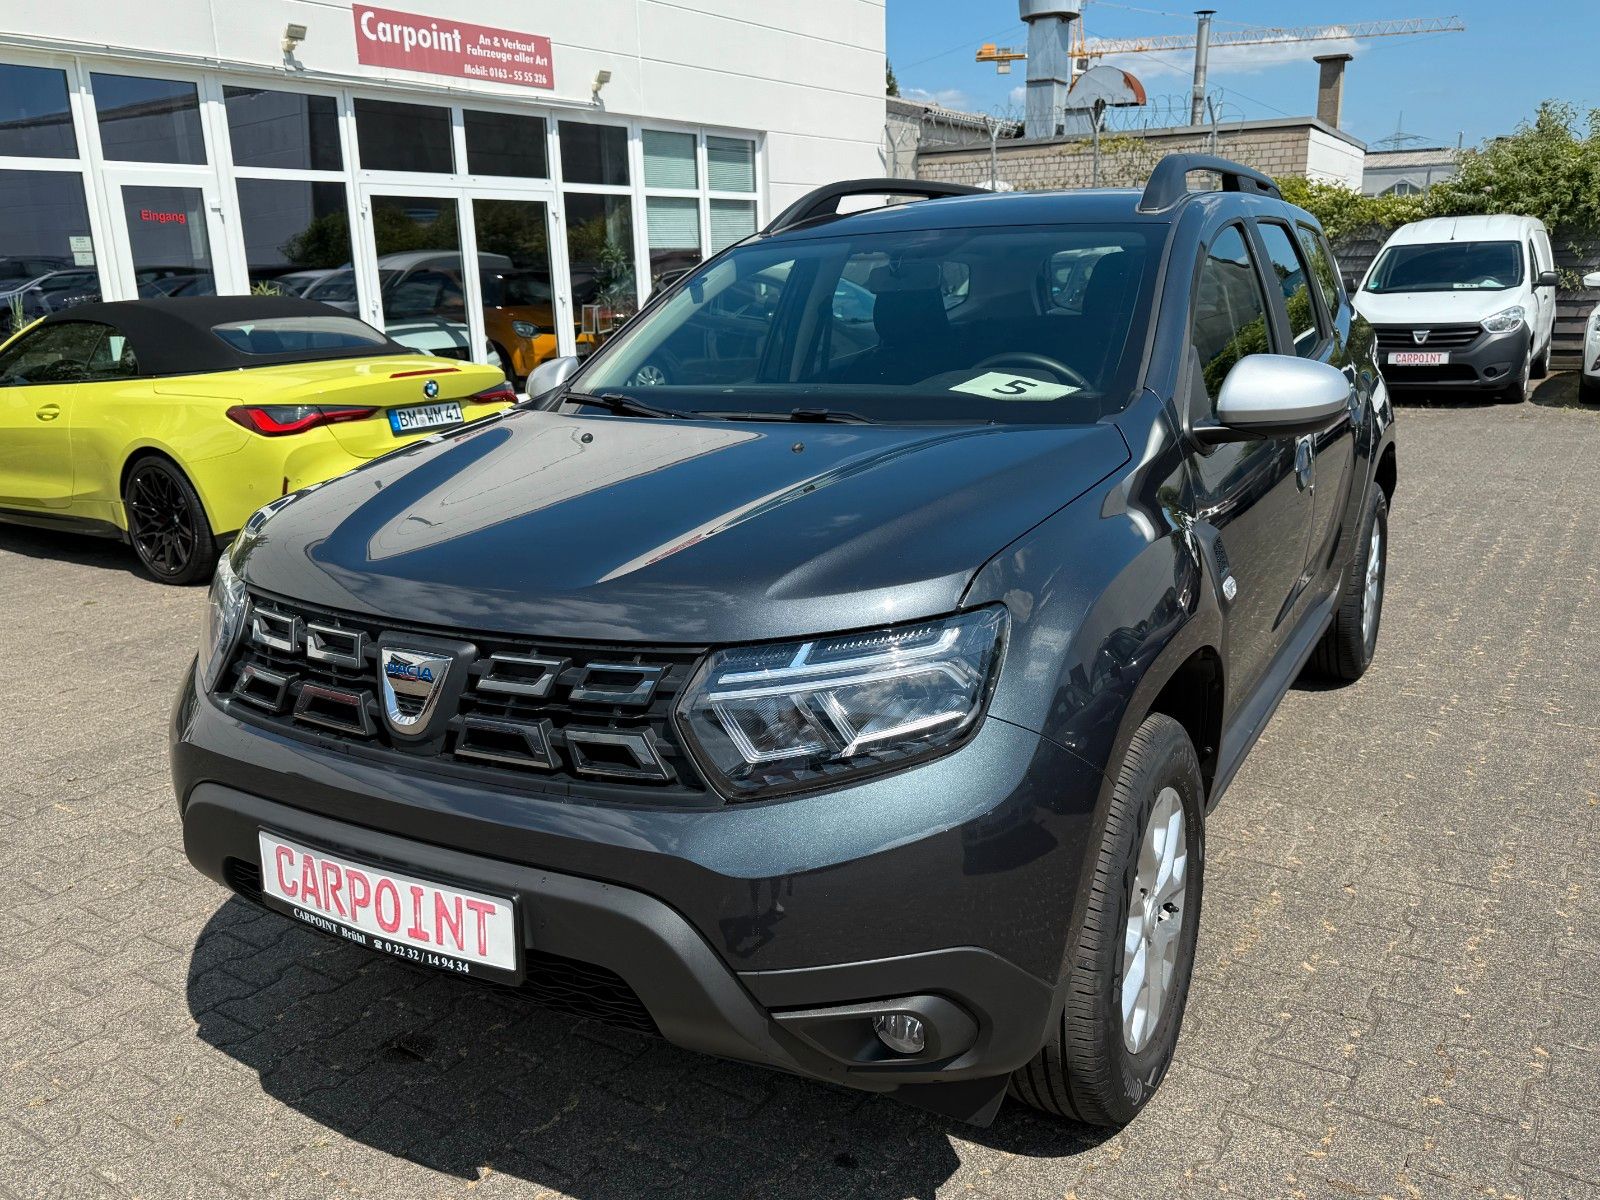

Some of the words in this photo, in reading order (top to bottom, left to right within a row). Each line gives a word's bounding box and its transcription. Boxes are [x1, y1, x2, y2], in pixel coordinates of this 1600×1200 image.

[360, 11, 462, 53] Carpoint
[479, 34, 491, 46] An
[493, 36, 500, 47] &
[502, 37, 535, 53] Verkauf
[466, 44, 512, 62] Fahrzeuge
[514, 52, 533, 64] aller
[535, 55, 548, 66] Art
[464, 64, 488, 76] Mobil:
[489, 67, 507, 79] 0163
[514, 70, 522, 81] 55
[524, 71, 533, 82] 55
[534, 72, 547, 84] 326
[140, 209, 187, 224] Eingang
[1395, 353, 1442, 363] CARPOINT
[992, 379, 1038, 395] 5
[398, 410, 419, 427] BM
[425, 407, 444, 423] WM
[446, 404, 461, 420] 41
[387, 661, 433, 681] DACIA
[275, 844, 496, 957] CARPOINT
[293, 908, 338, 934] CARPOINT
[341, 926, 366, 945] Brühl
[385, 942, 391, 952] 0
[393, 945, 405, 956] 22
[407, 948, 420, 960] 32
[427, 954, 440, 966] 14
[441, 959, 455, 970] 94
[456, 961, 470, 974] 34
